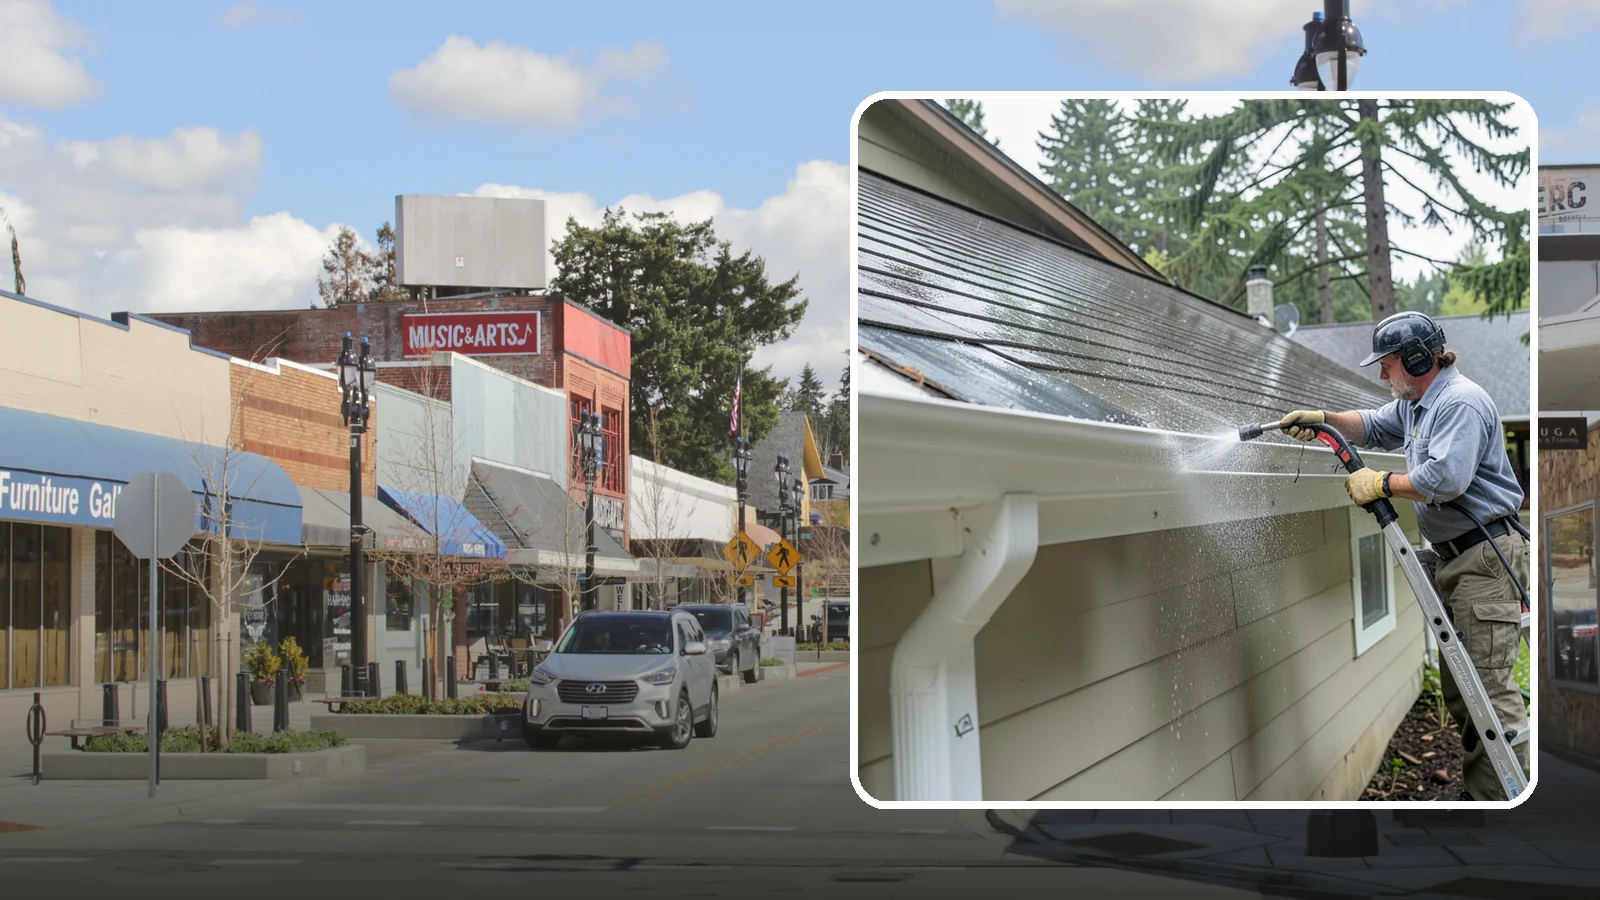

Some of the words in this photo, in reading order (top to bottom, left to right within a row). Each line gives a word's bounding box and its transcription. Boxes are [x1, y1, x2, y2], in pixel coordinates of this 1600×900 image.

[1538, 181, 1586, 213] ERC
[409, 322, 518, 349] MUSIC&ARTS
[1540, 427, 1577, 436] UGA
[0, 471, 79, 515] Furniture
